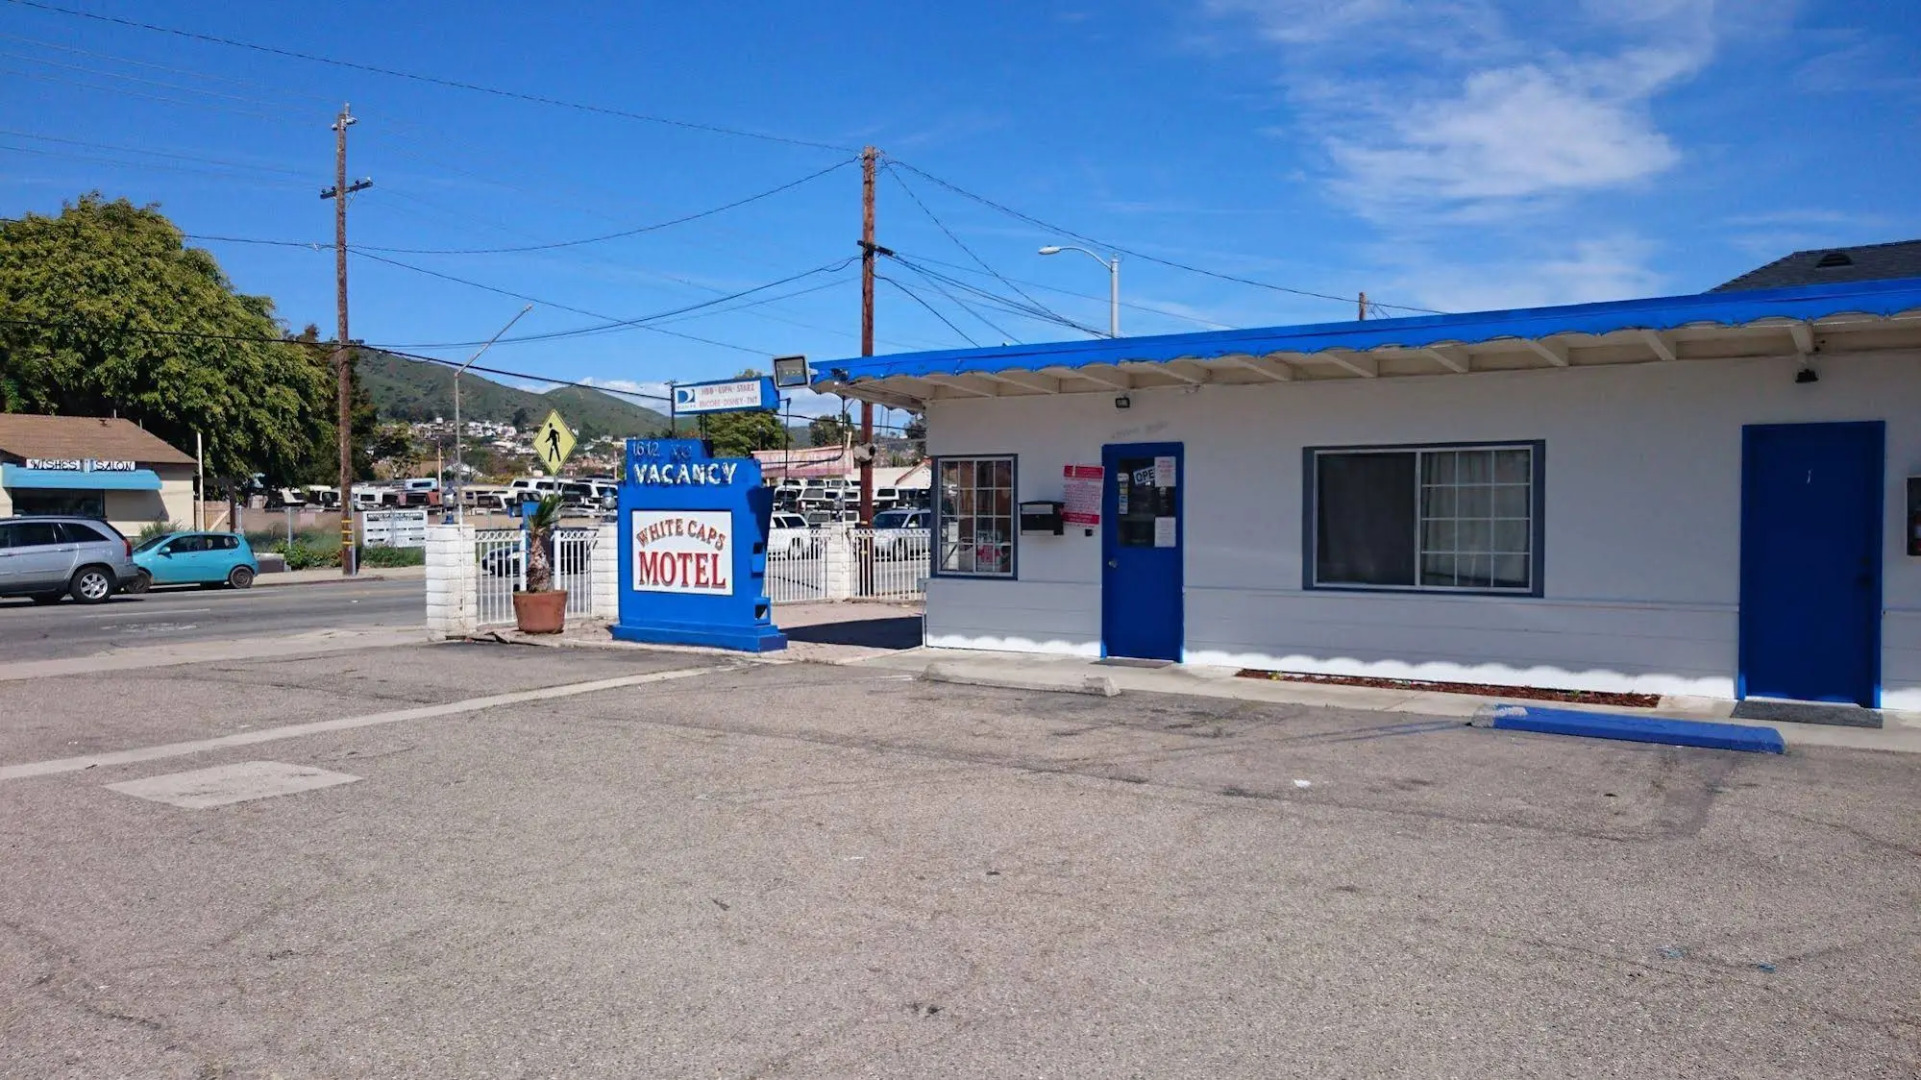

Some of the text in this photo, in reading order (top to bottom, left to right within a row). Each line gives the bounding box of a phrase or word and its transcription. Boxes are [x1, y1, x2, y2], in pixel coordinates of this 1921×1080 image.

[632, 441, 660, 457] 1612
[94, 460, 134, 471] SALON
[633, 462, 738, 484] VACANCY
[1135, 468, 1156, 483] OPE
[636, 518, 727, 551] WHITE CAPS
[638, 551, 727, 589] MOTEL
